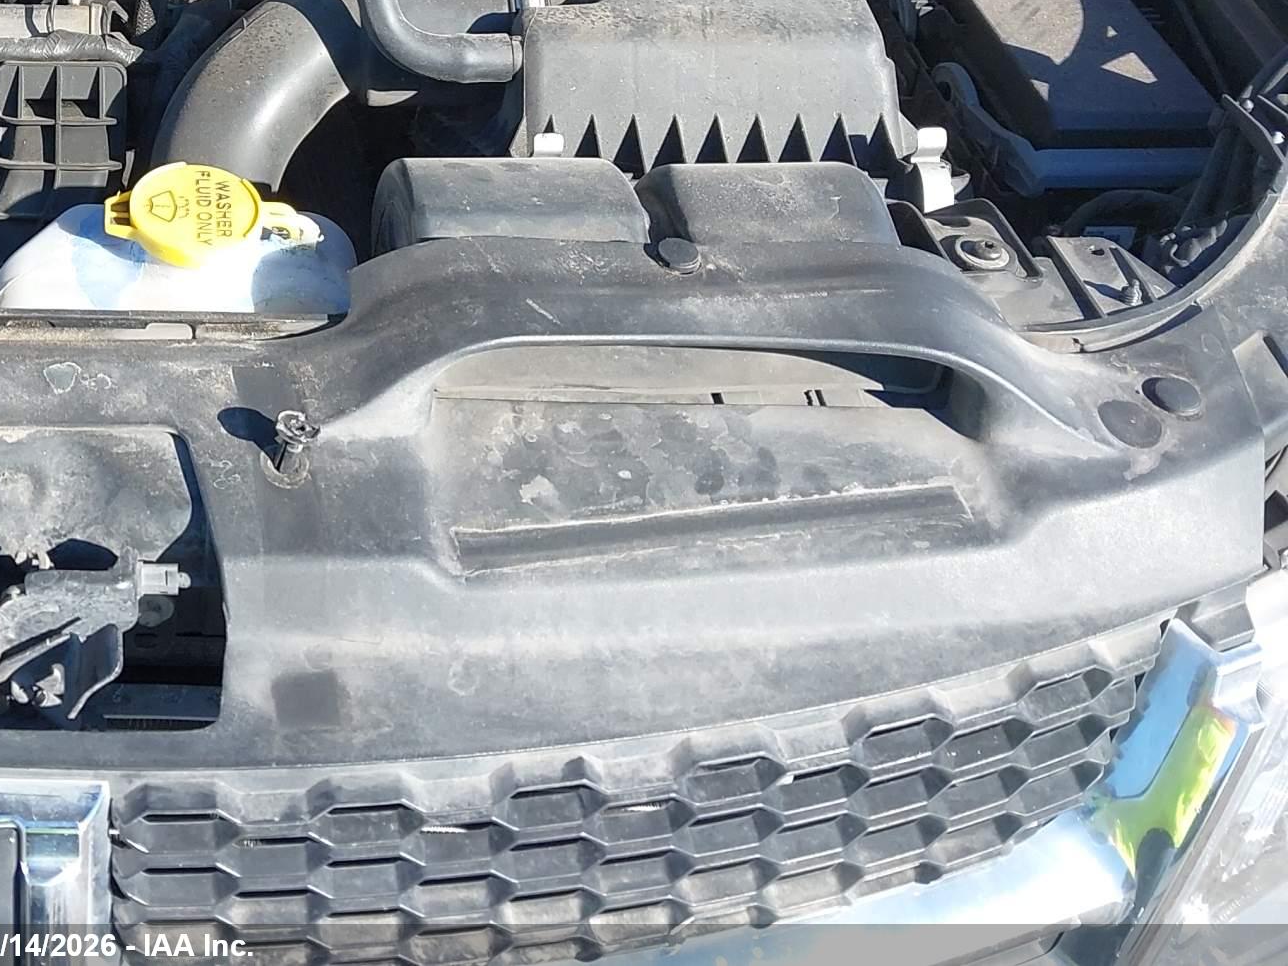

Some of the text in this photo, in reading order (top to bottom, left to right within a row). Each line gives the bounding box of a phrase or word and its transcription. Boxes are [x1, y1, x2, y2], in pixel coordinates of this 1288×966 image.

[195, 170, 212, 246] FLUID ONLY
[215, 180, 233, 238] WASHER
